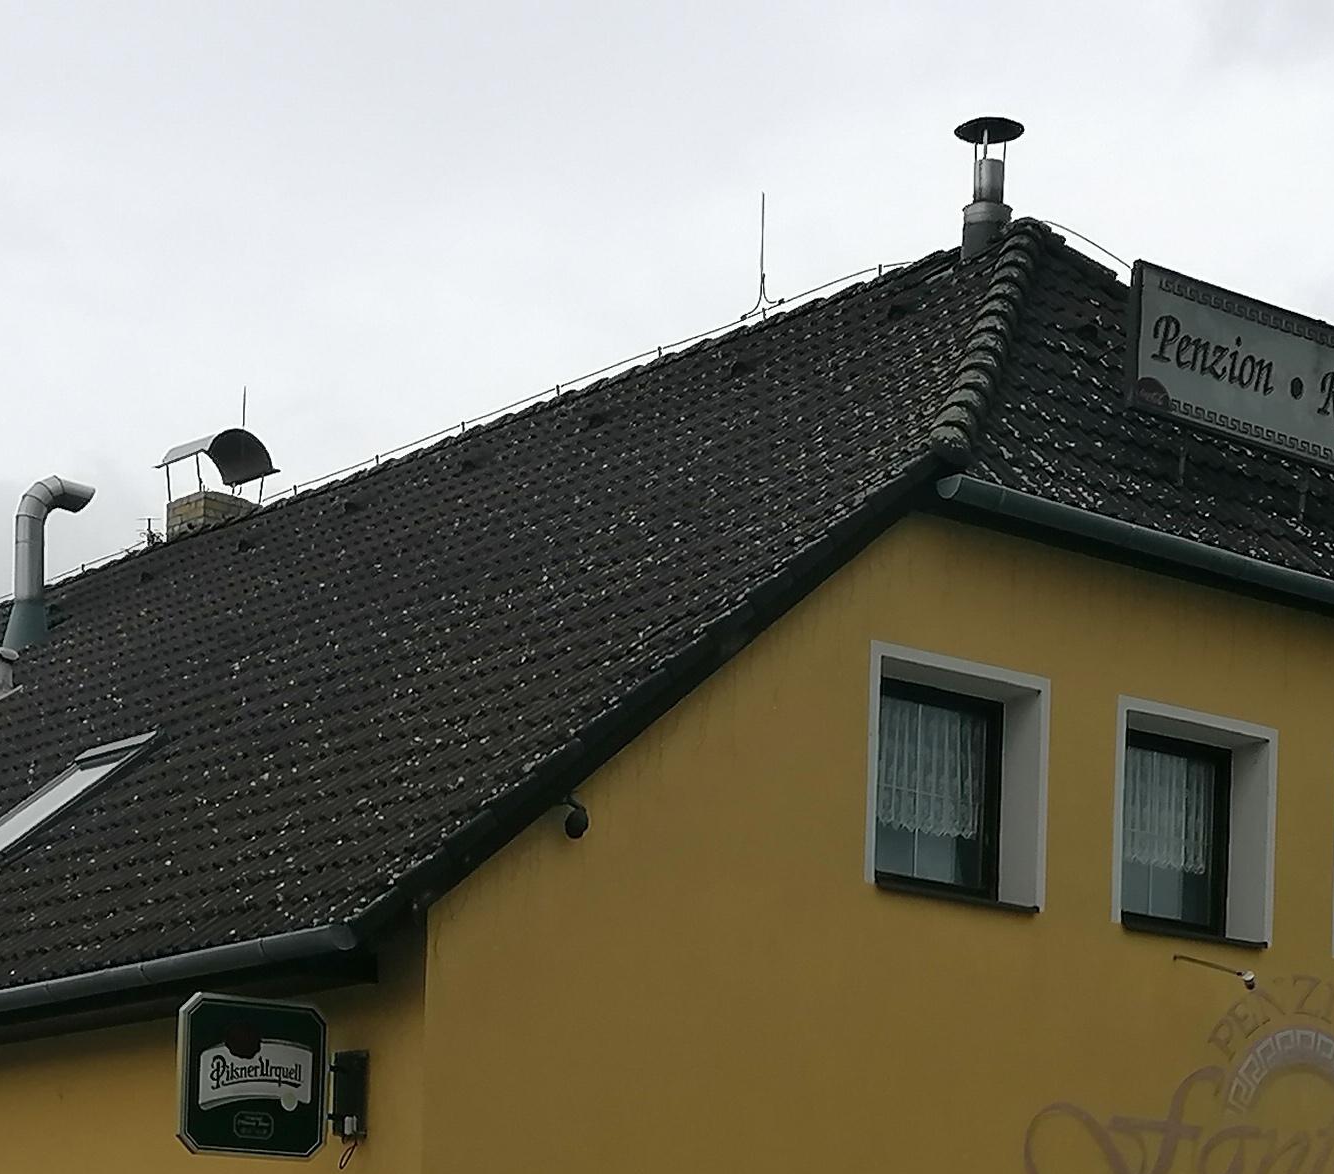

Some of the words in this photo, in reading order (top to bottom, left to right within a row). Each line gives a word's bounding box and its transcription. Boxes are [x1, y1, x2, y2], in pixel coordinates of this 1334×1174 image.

[1151, 314, 1275, 395] Penzion
[209, 1054, 261, 1090] Pilsner
[259, 1057, 301, 1086] Urquell
